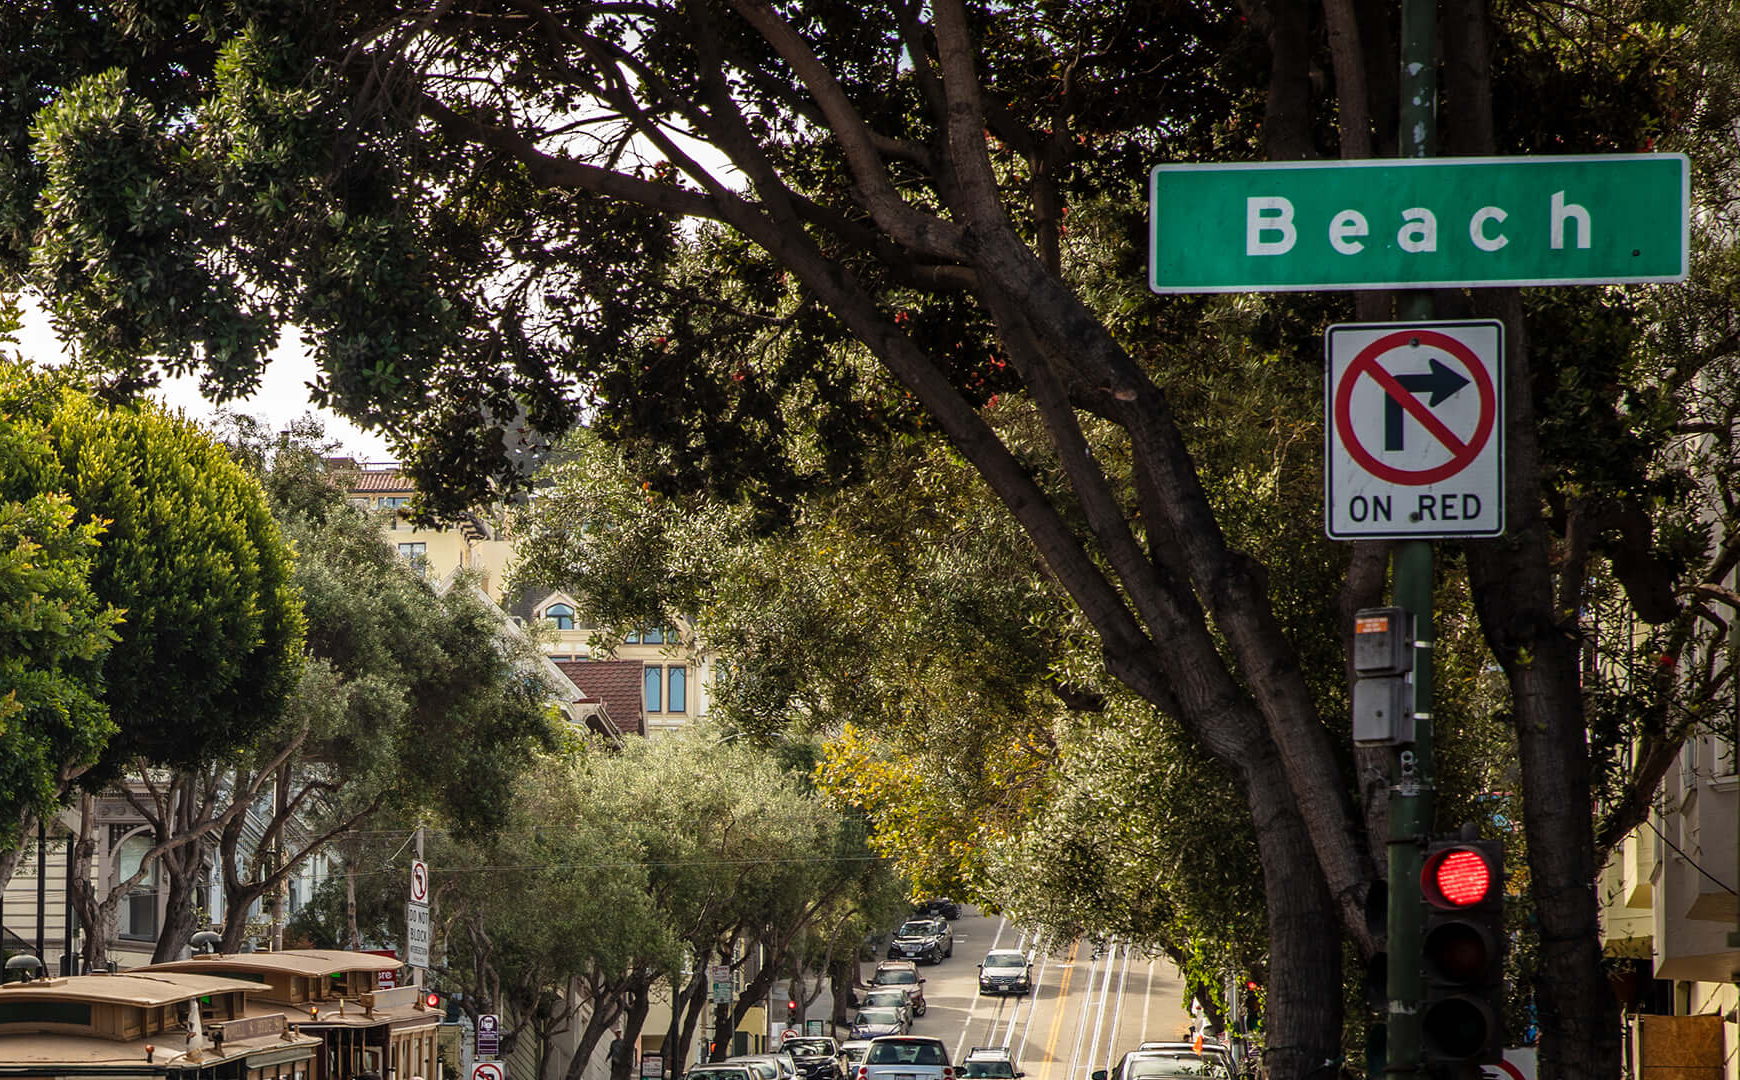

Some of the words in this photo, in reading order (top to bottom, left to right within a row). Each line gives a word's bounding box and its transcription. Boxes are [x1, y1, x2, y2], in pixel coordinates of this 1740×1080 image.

[1245, 190, 1592, 257] Beach
[1350, 496, 1392, 522] ON
[1418, 494, 1482, 522] RED
